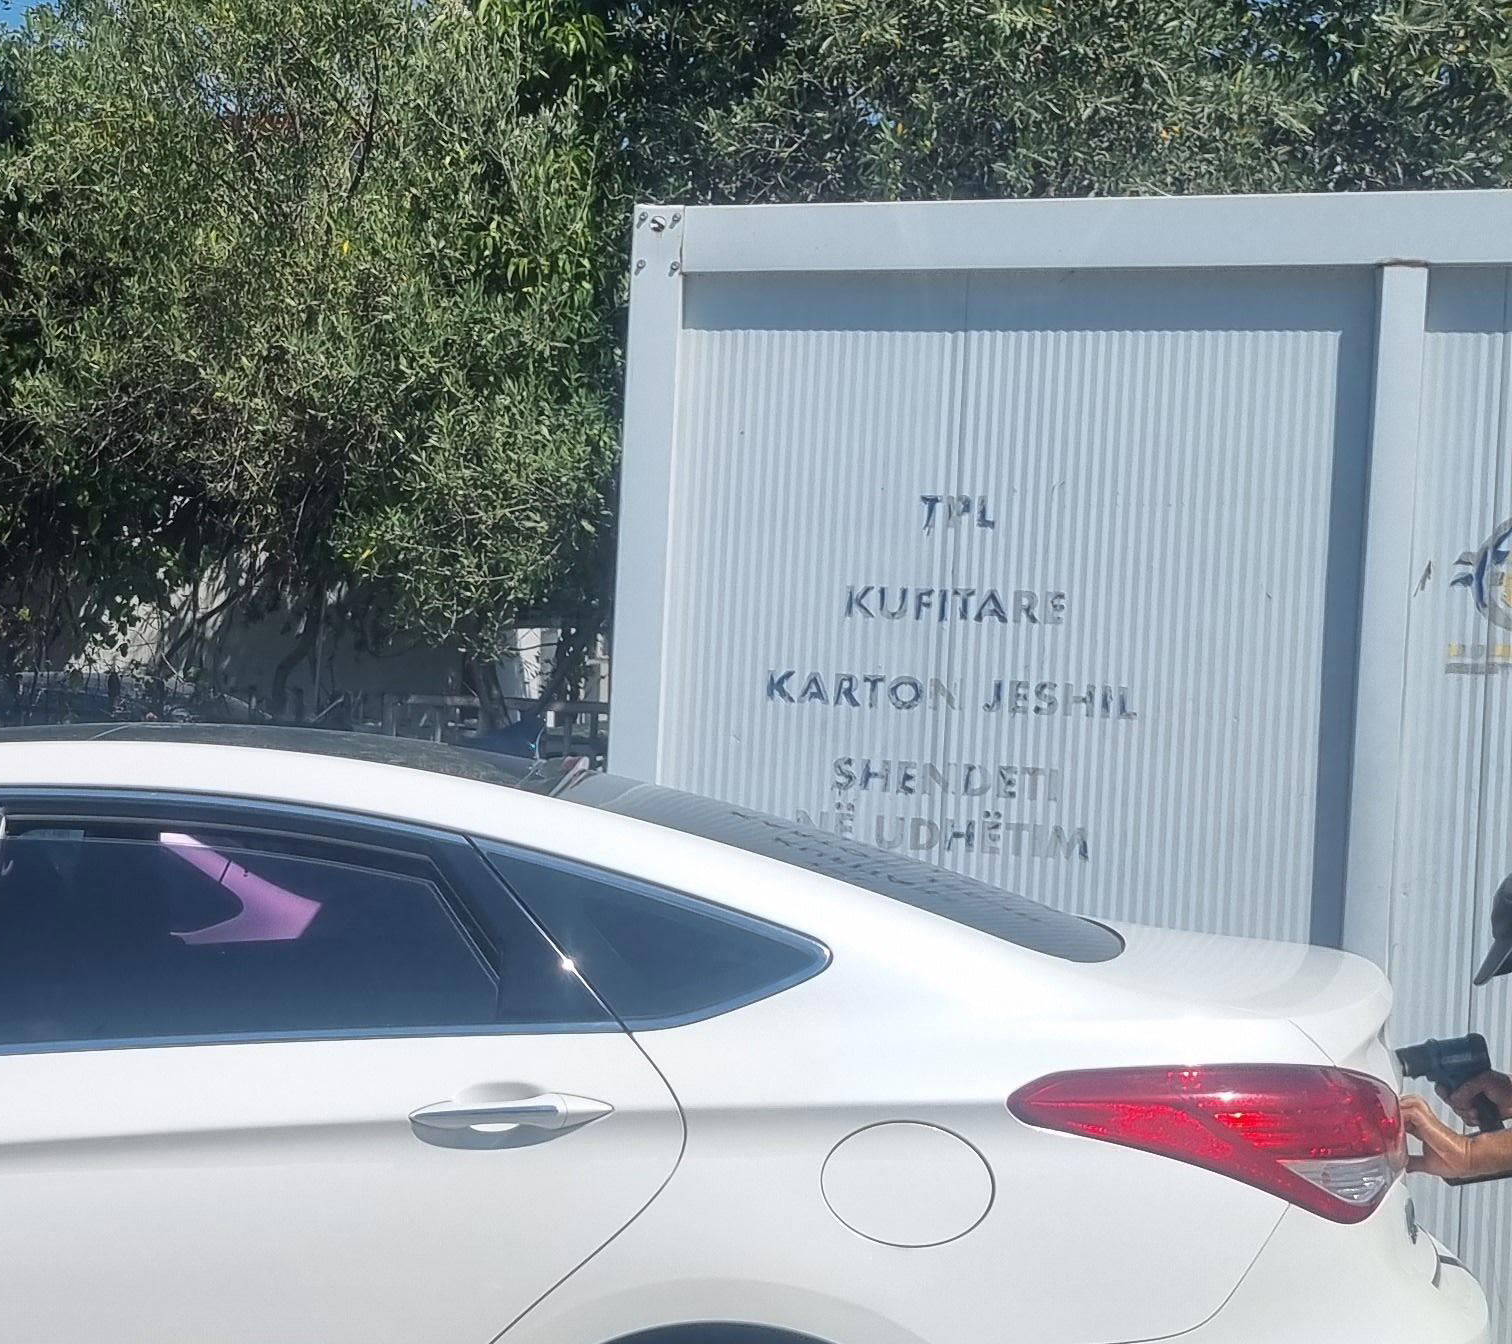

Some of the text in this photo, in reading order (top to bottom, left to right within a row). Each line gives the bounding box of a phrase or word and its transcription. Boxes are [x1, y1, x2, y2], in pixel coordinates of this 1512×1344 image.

[919, 493, 995, 534] TPL
[844, 584, 1067, 625] KUFITARE
[766, 668, 1138, 720] KARTON JESHIL
[831, 756, 1059, 803] SHENDETI
